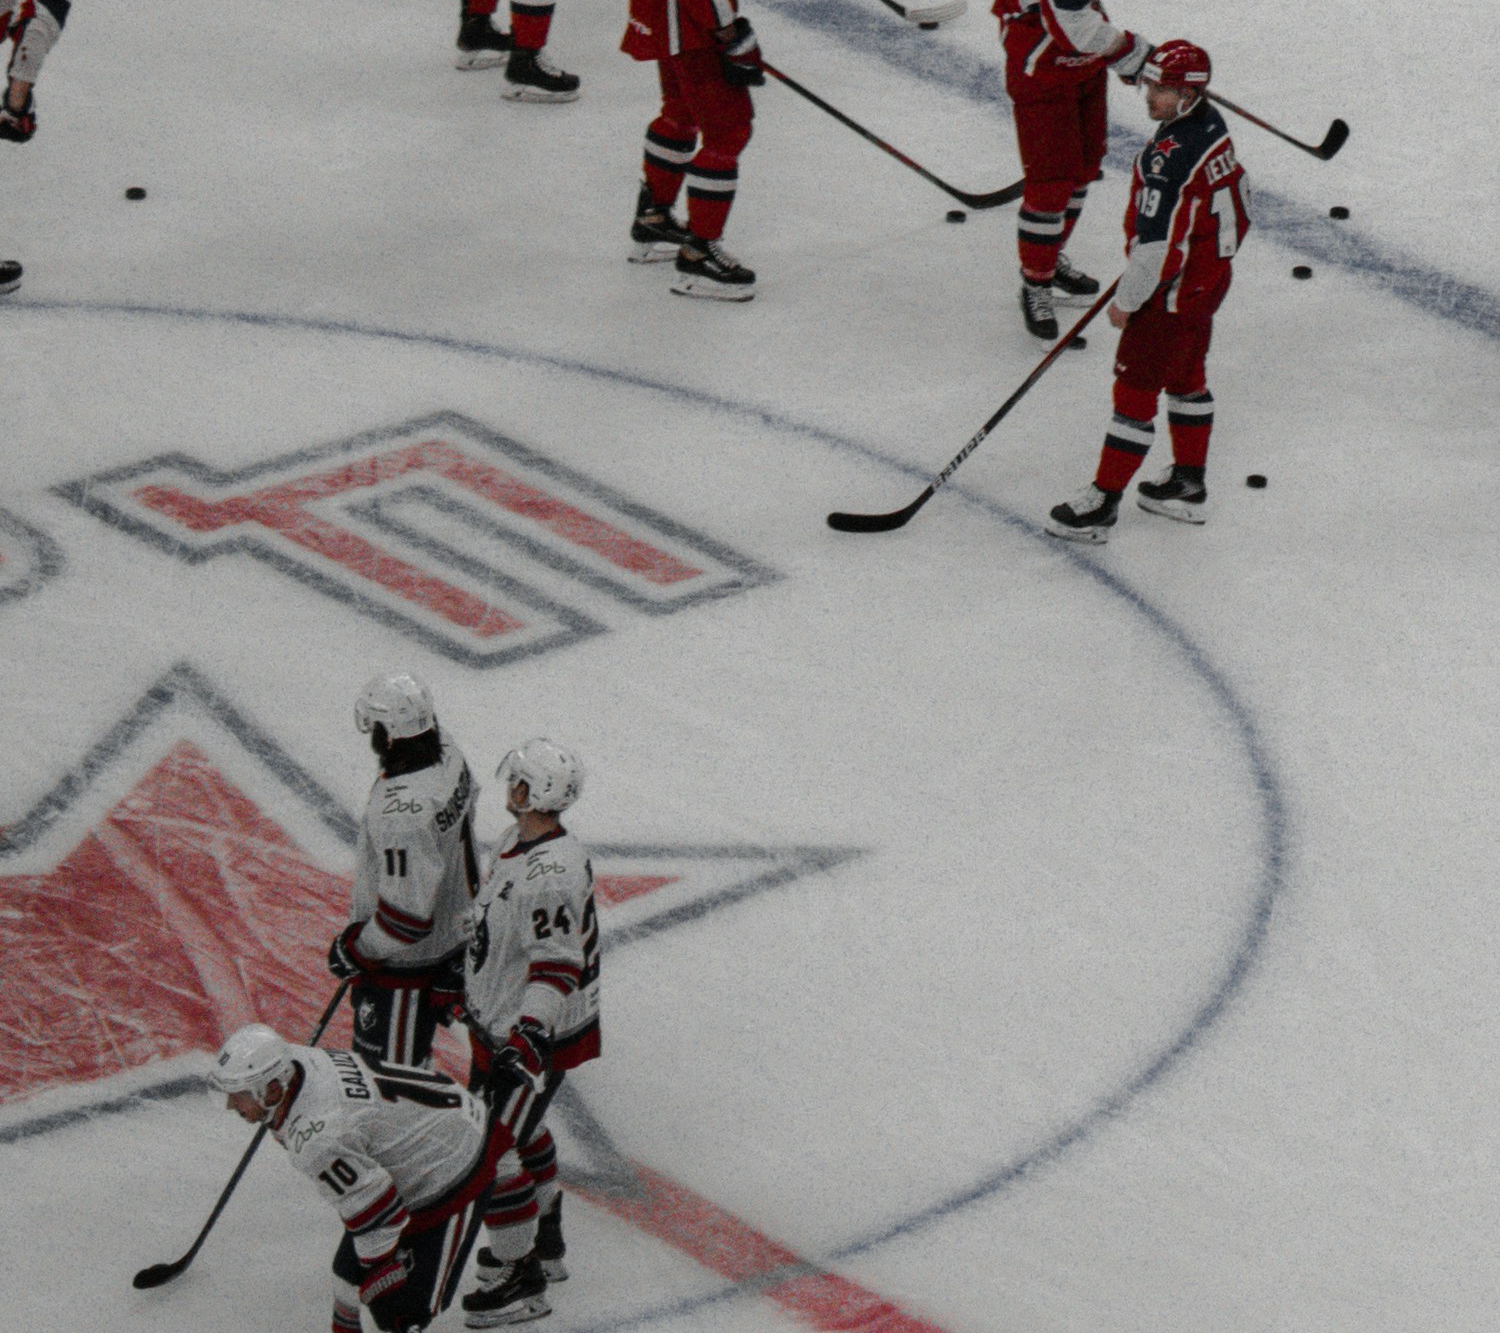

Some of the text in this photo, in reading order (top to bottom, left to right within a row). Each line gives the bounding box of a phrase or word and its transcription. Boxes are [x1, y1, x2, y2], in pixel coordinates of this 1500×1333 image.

[384, 848, 407, 877] 11
[532, 905, 571, 940] 24
[317, 1157, 367, 1196] 10
